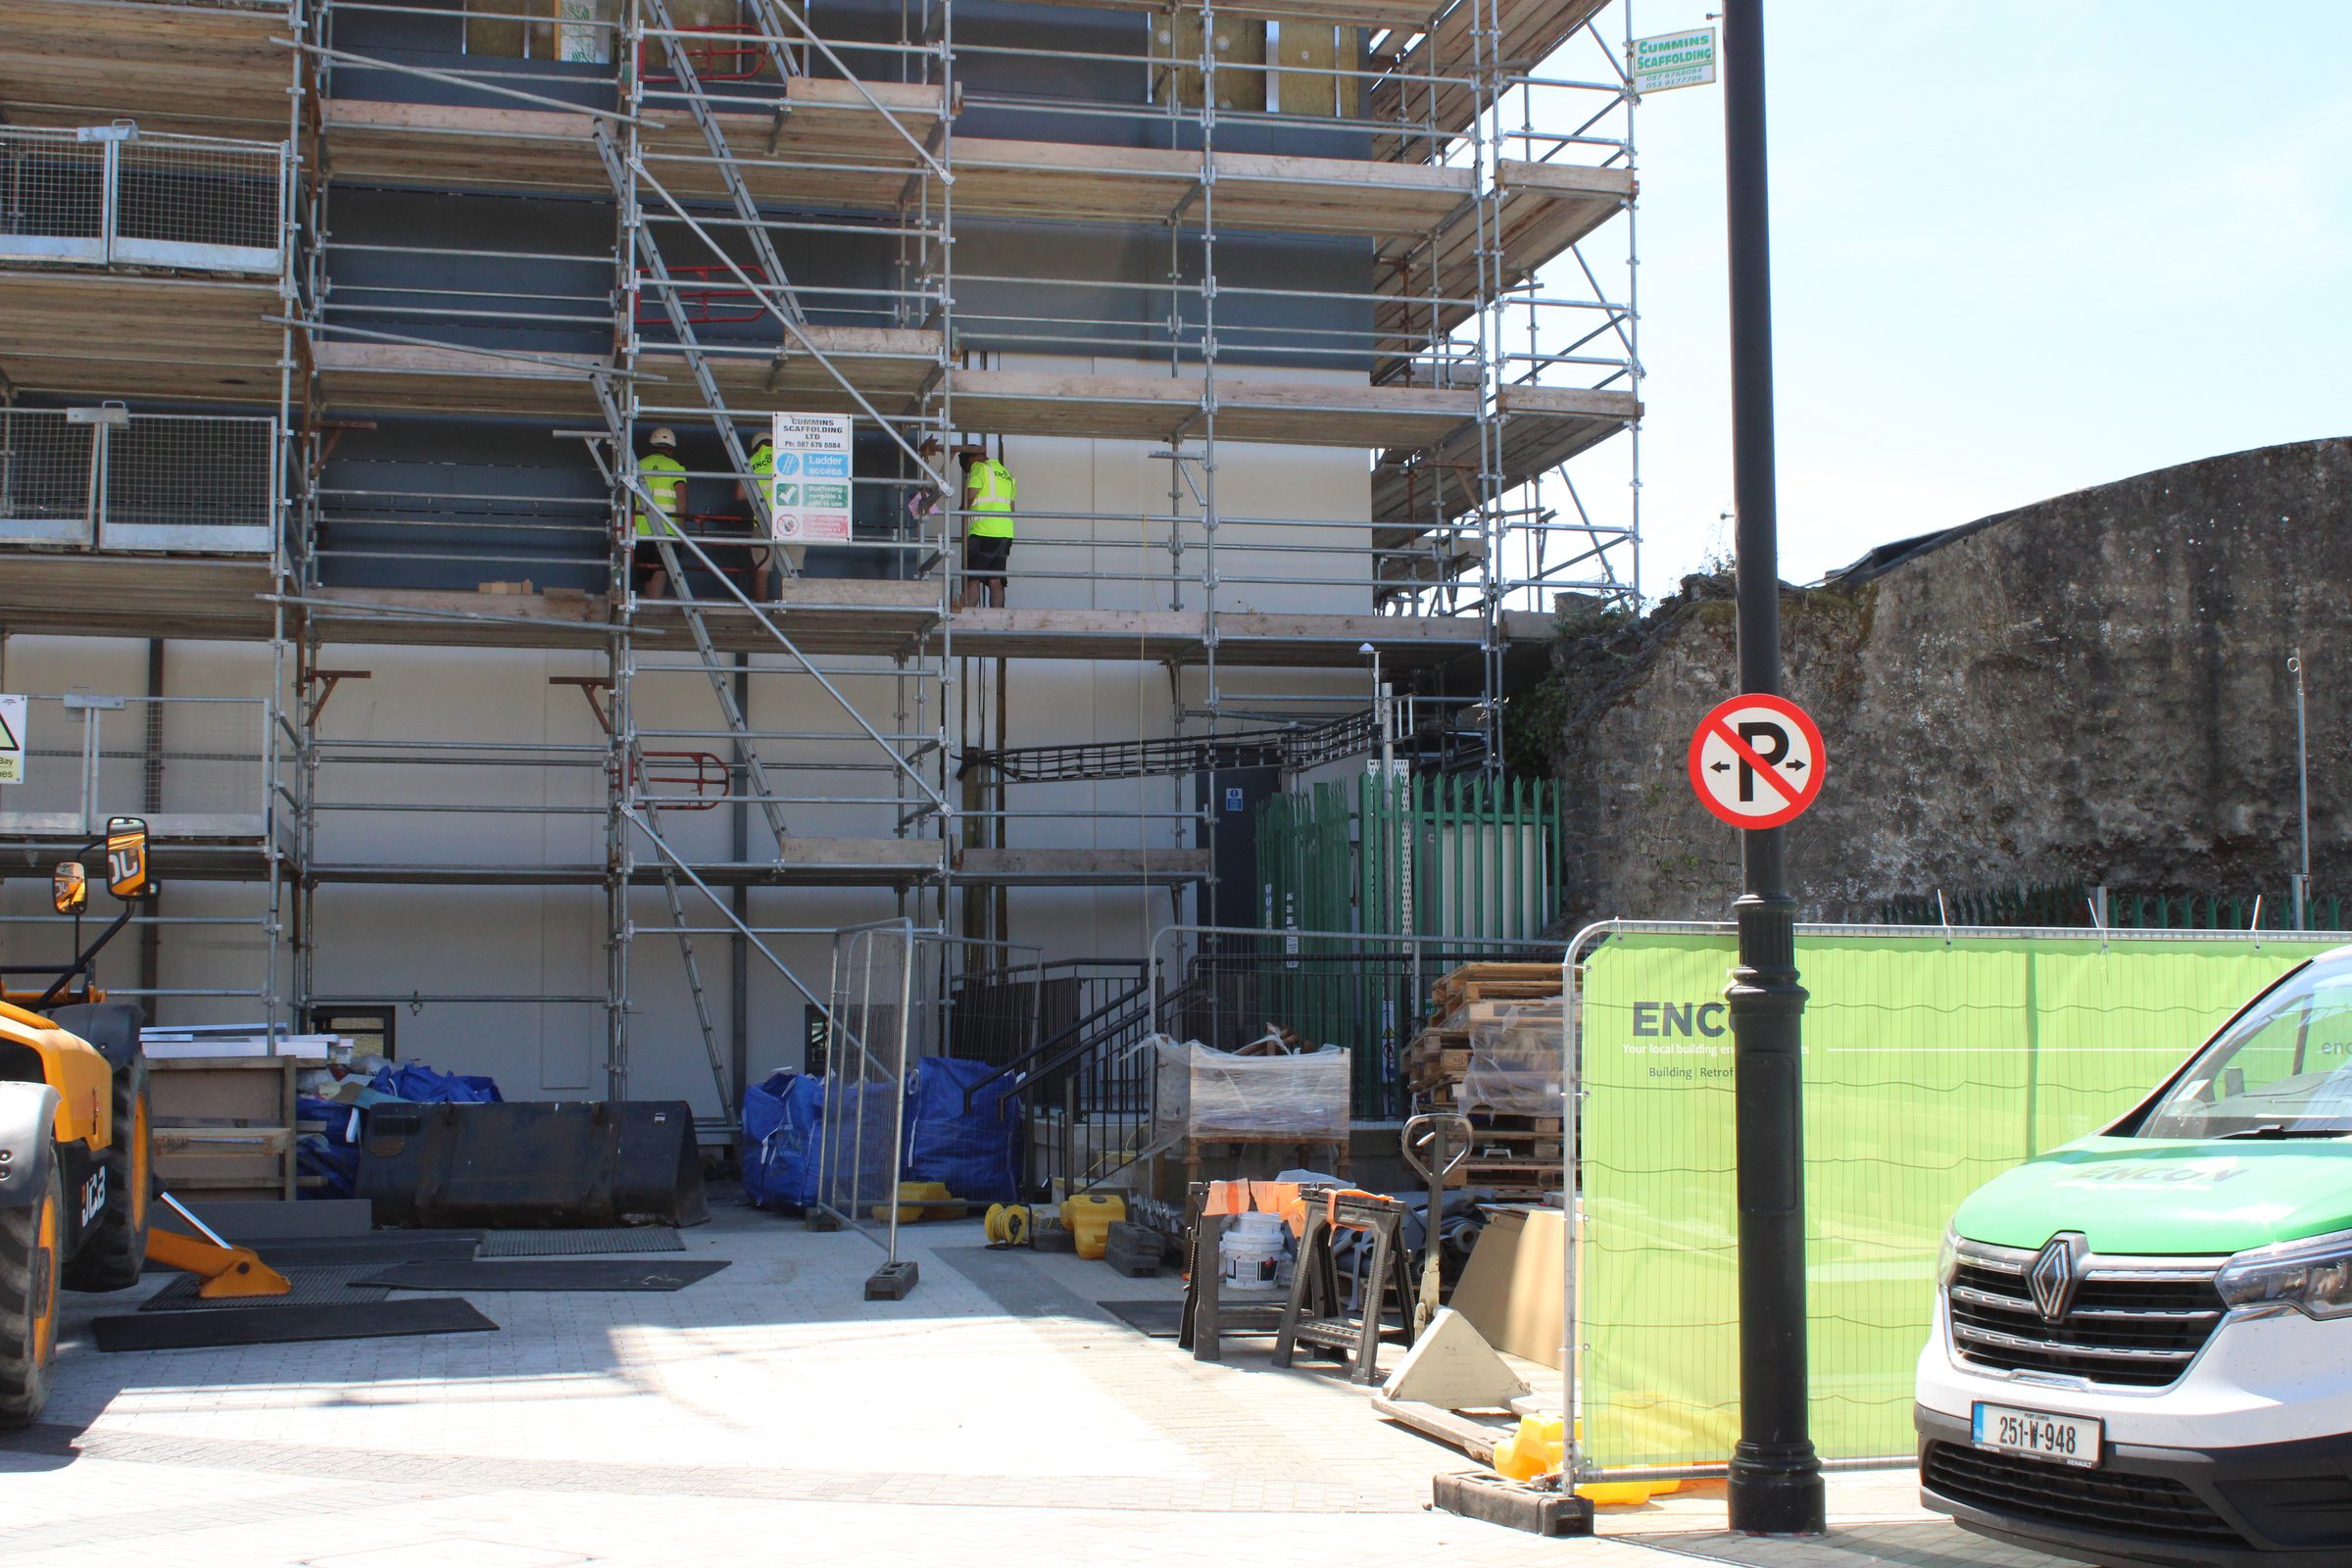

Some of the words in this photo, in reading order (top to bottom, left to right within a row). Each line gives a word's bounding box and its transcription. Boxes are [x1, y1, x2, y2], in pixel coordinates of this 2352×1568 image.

[1639, 35, 1709, 54] CUMMINS
[1638, 48, 1711, 69] SCAFFOLDING
[808, 456, 842, 465] Ladder
[808, 467, 843, 476] access
[1633, 1002, 1736, 1037] ENC
[1623, 1044, 1646, 1054] Your
[1649, 1044, 1674, 1054] local
[1676, 1044, 1717, 1057] building
[1649, 1067, 1692, 1080] Building
[81, 1165, 106, 1227] JCB
[1999, 1416, 2076, 1454] 251-W-948
[2067, 1459, 2091, 1468] RENAULT
